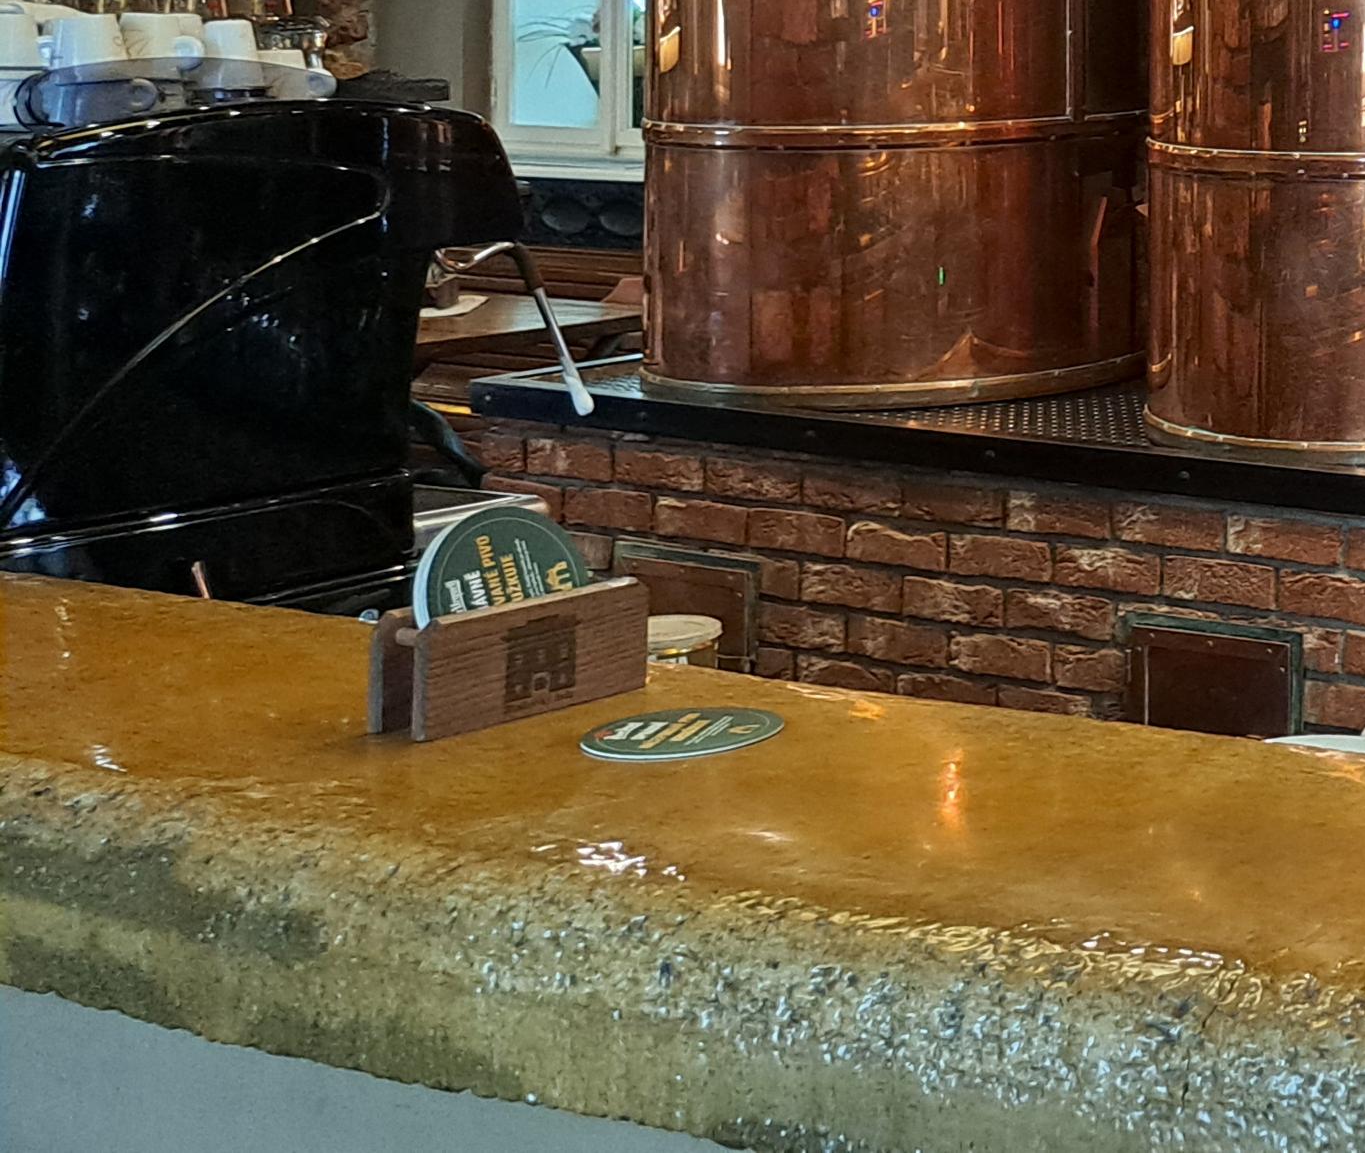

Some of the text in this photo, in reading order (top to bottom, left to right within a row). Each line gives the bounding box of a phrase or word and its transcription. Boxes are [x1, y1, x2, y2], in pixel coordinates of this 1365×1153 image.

[475, 535, 506, 606] VANÉ PIVO
[500, 553, 524, 602] UŽKUJE
